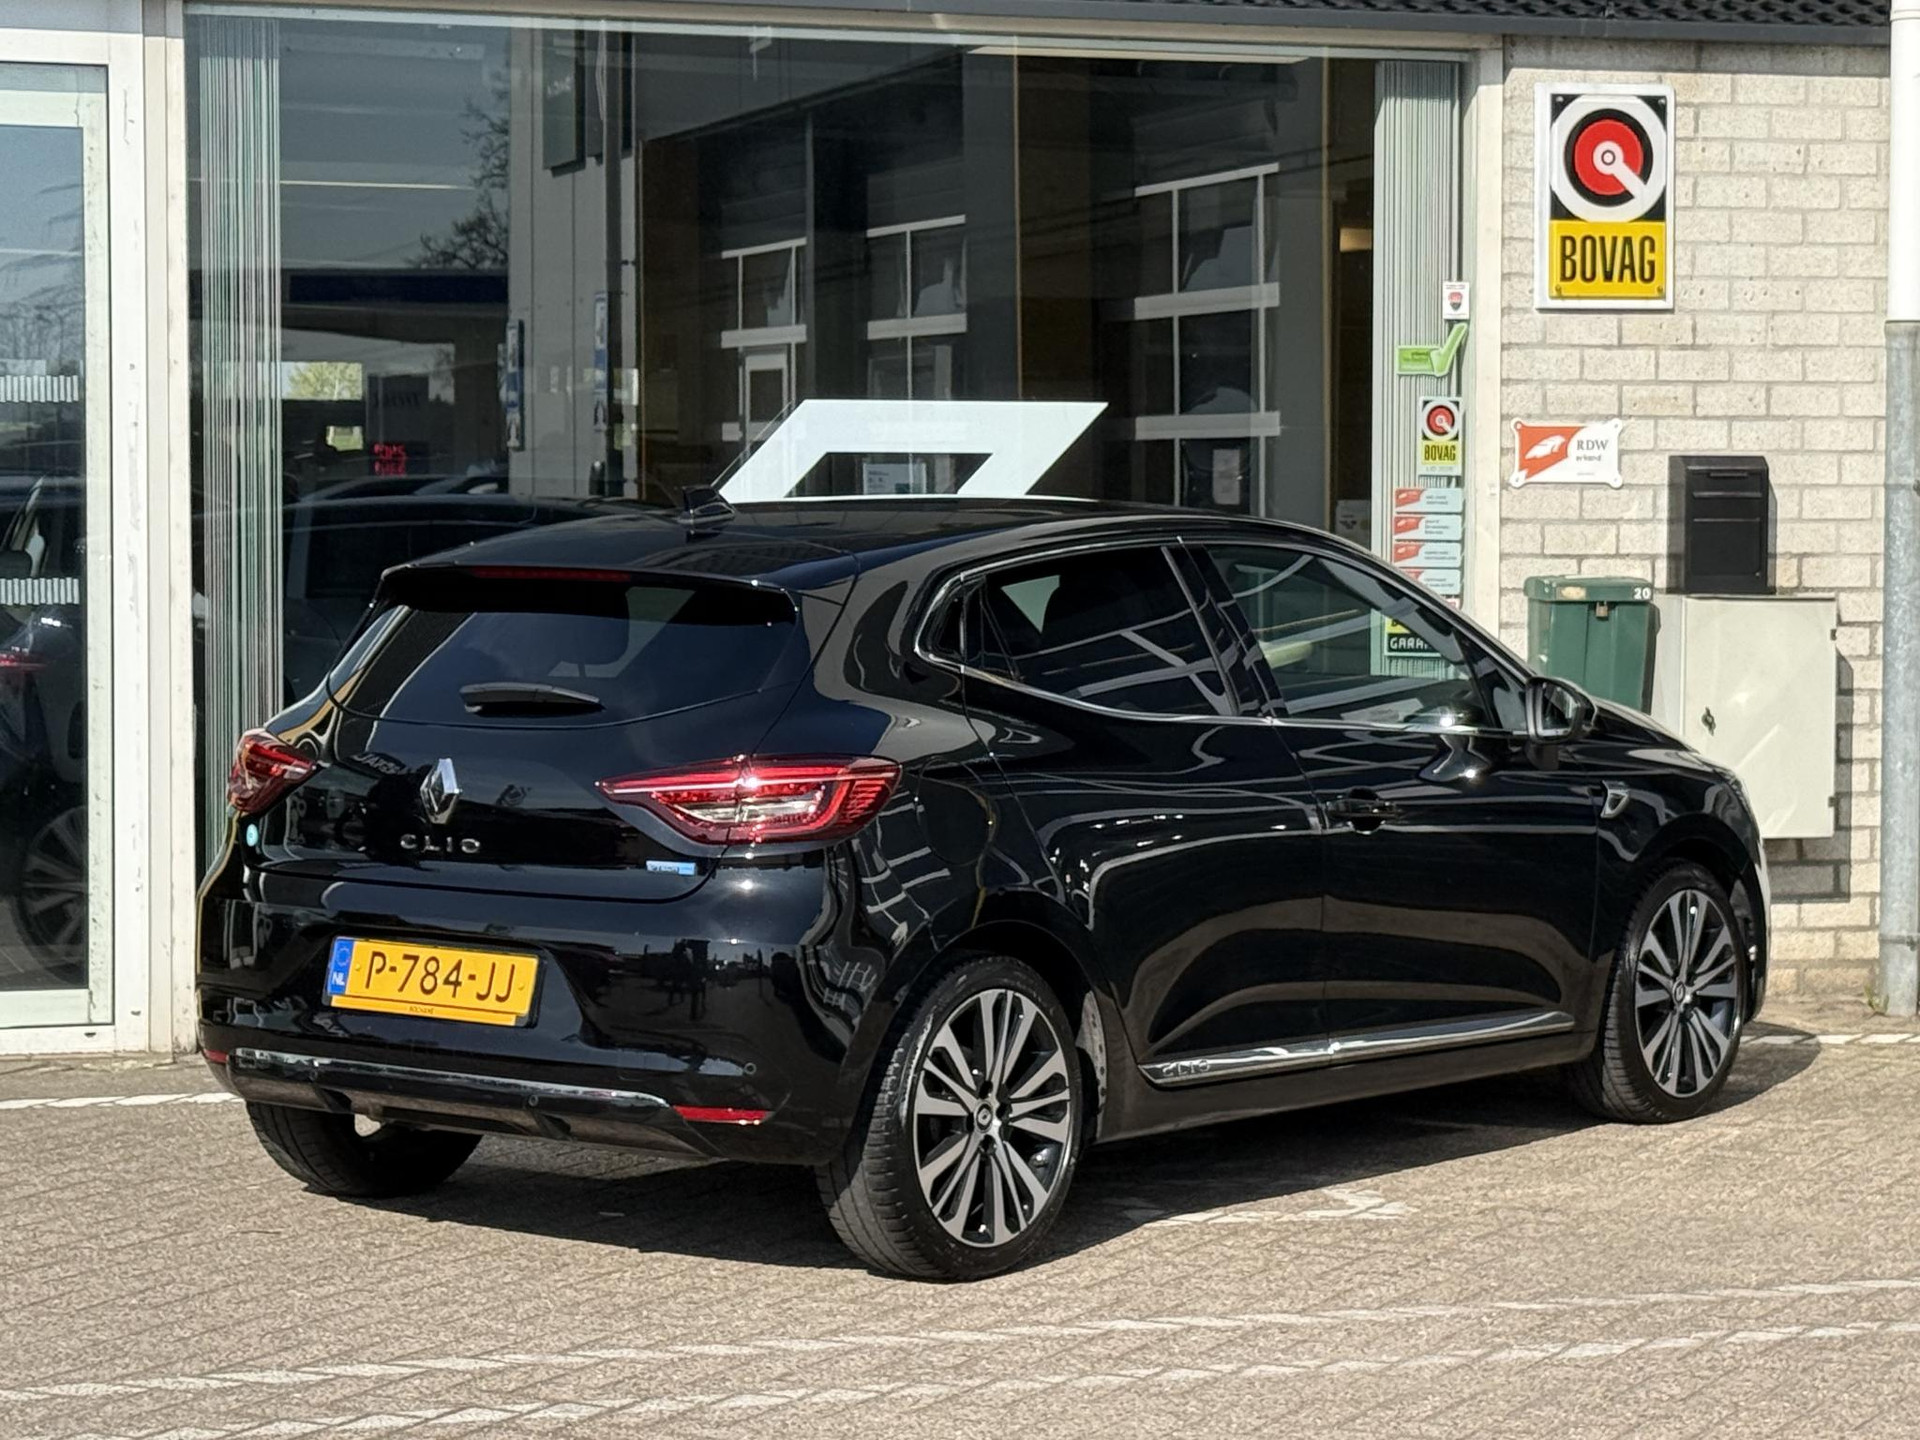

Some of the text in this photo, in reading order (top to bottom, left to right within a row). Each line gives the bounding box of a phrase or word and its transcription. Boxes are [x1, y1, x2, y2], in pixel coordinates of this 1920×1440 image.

[1560, 235, 1656, 283] BOVAG
[1424, 444, 1456, 461] BOVAG
[1577, 439, 1609, 451] RDW
[1633, 587, 1652, 600] 20
[1389, 636, 1429, 650] GARA
[400, 833, 480, 853] CLIO
[332, 972, 346, 986] NL
[365, 950, 516, 1003] P-784-JJ
